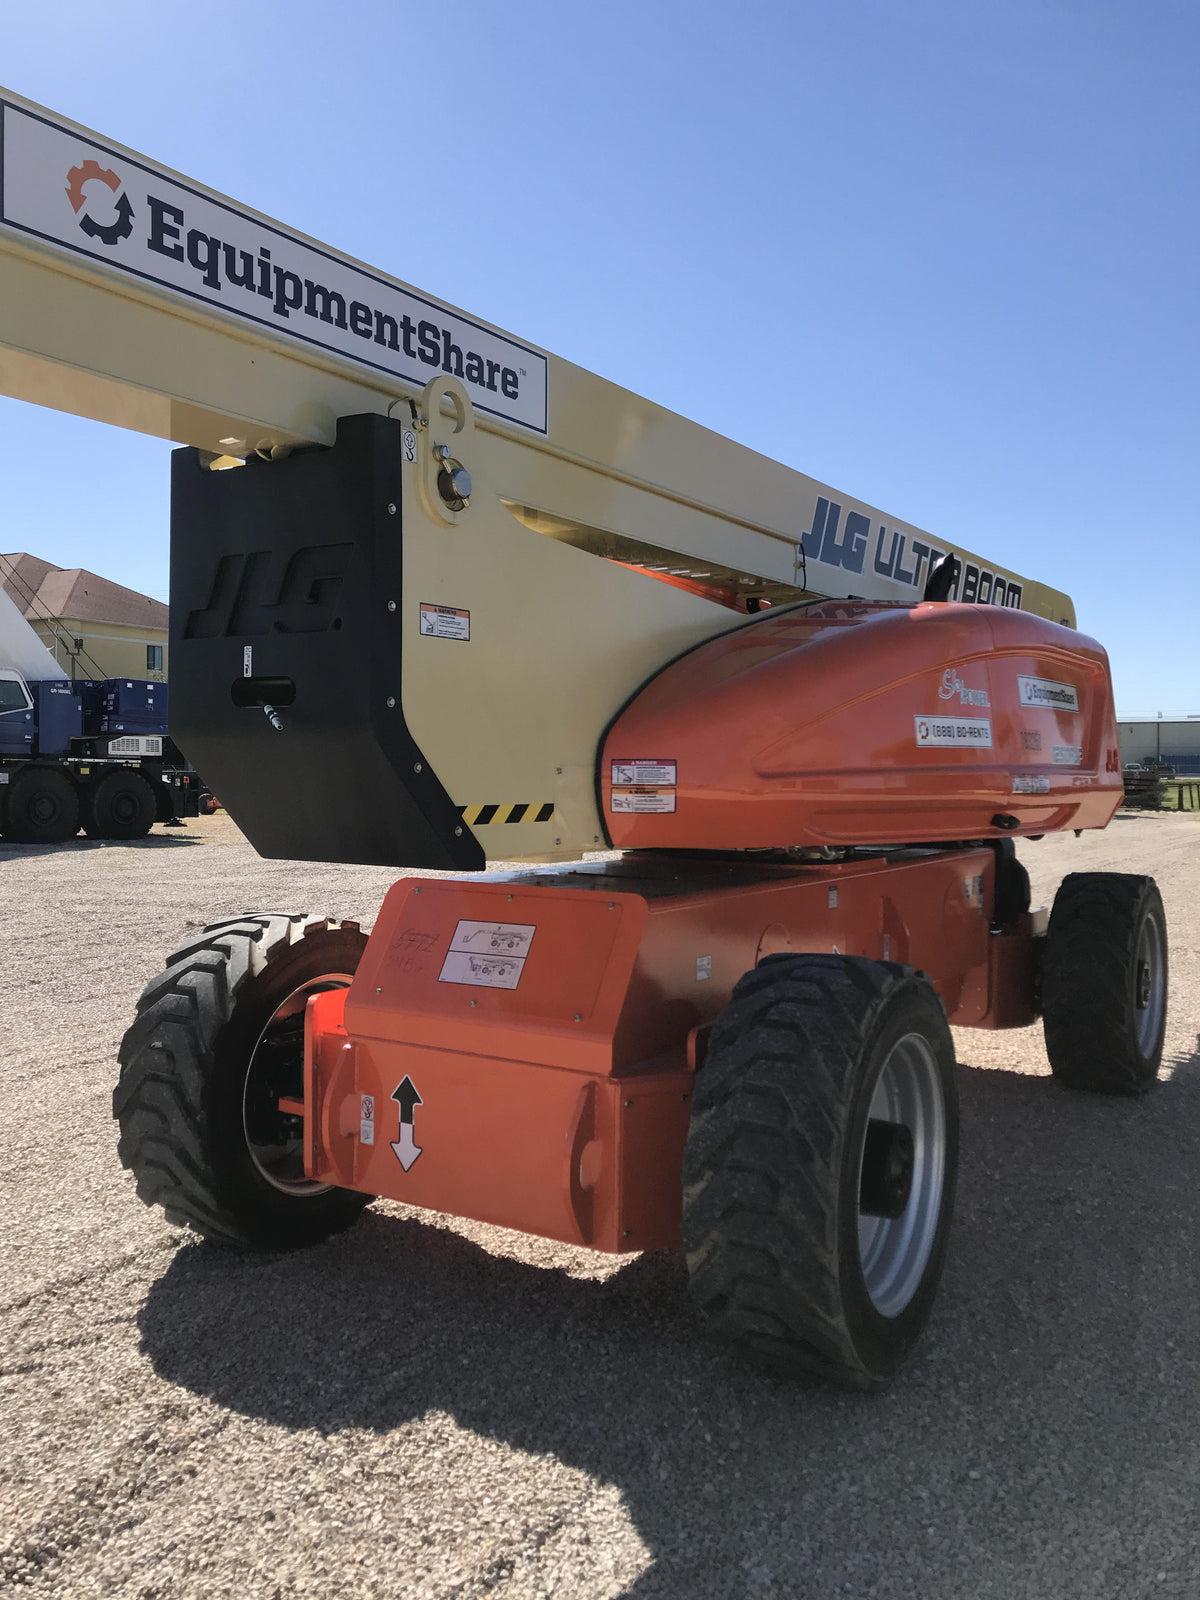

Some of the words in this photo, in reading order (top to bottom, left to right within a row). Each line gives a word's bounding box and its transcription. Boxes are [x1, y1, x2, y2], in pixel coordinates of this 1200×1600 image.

[147, 195, 518, 400] EquipmentShare
[801, 496, 871, 575] JLG
[183, 543, 354, 639] JLG
